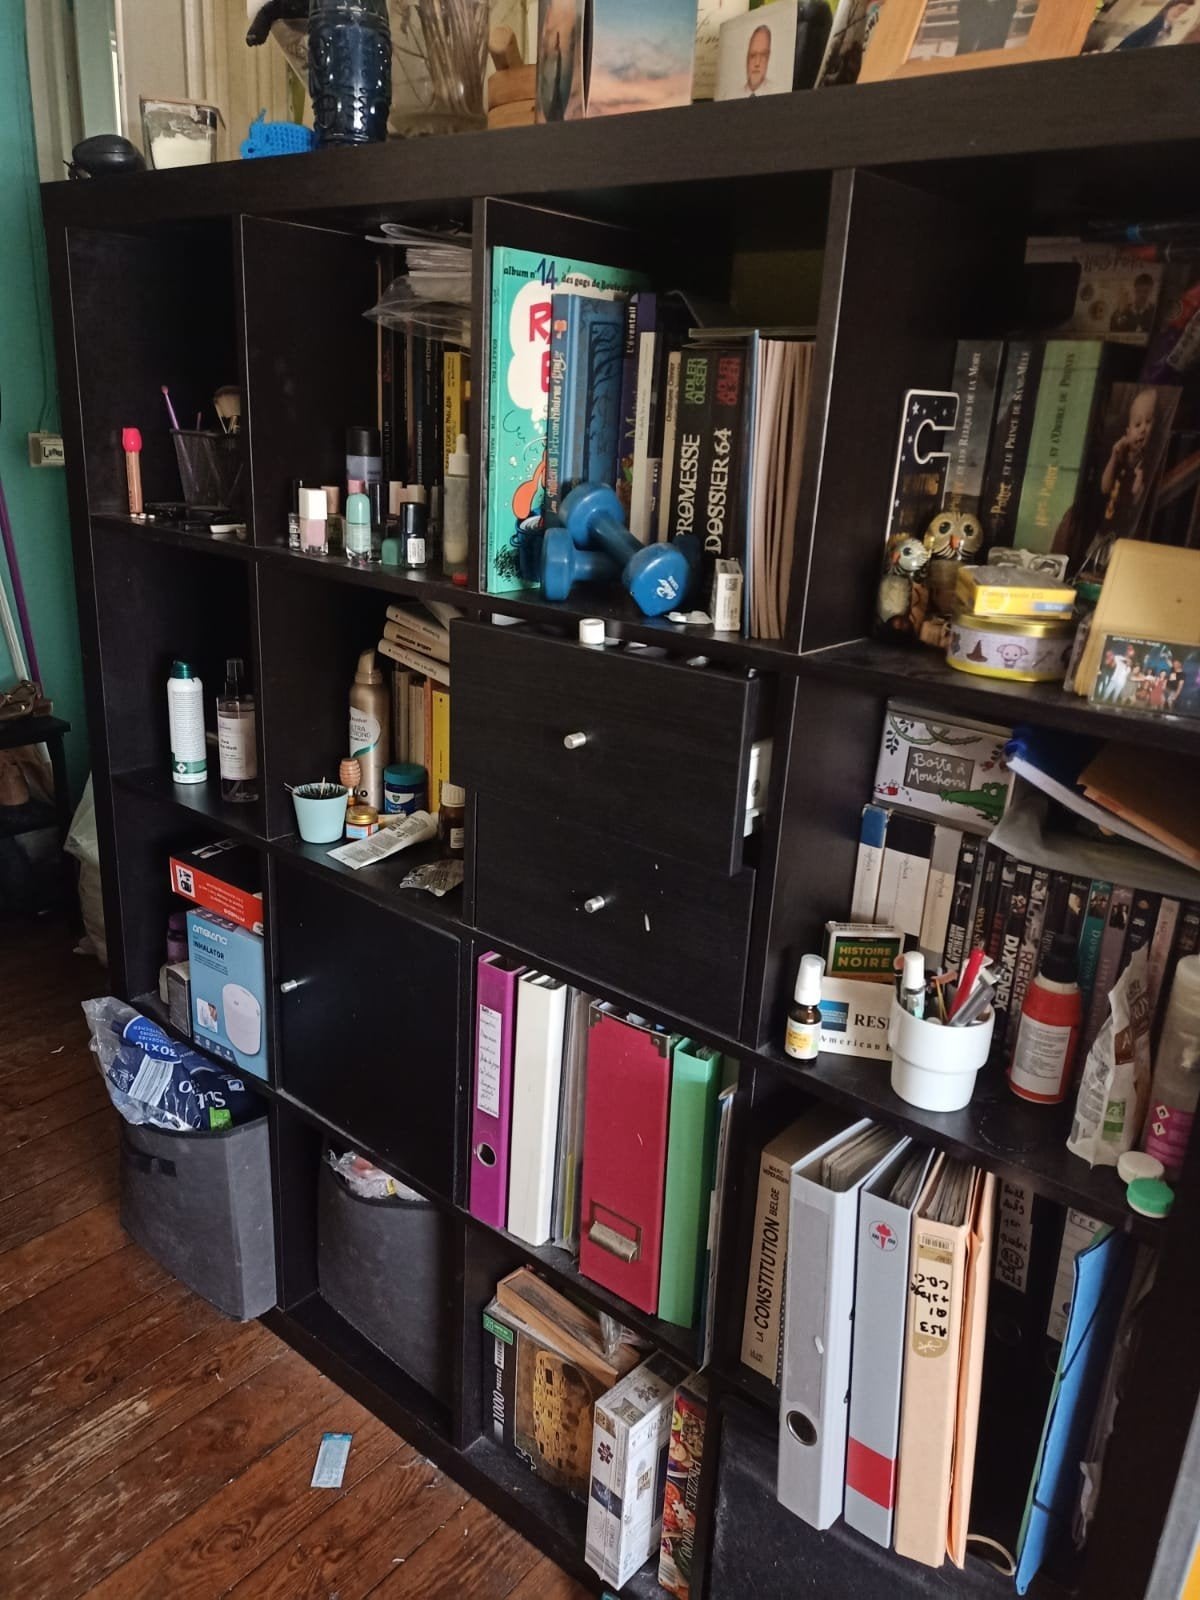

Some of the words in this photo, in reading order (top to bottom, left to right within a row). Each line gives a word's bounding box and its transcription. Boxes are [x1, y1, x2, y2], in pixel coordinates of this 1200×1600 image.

[503, 265, 529, 278] album
[561, 274, 574, 285] des
[574, 276, 590, 288] gags
[694, 358, 708, 405] OLSEN
[713, 427, 732, 457] 64
[704, 456, 730, 555] DOSSIER
[837, 956, 890, 969] NOIRE
[839, 946, 892, 957] HISTOIRE
[854, 1013, 890, 1031] RES
[820, 1034, 881, 1051] American
[769, 1187, 780, 1217] BELGE
[754, 1216, 780, 1330] CONSTITUTION
[755, 1331, 764, 1342] LA
[495, 1367, 503, 1392] PUZZLE
[492, 1389, 505, 1425] 1000
[684, 1457, 702, 1511] PUZZLE
